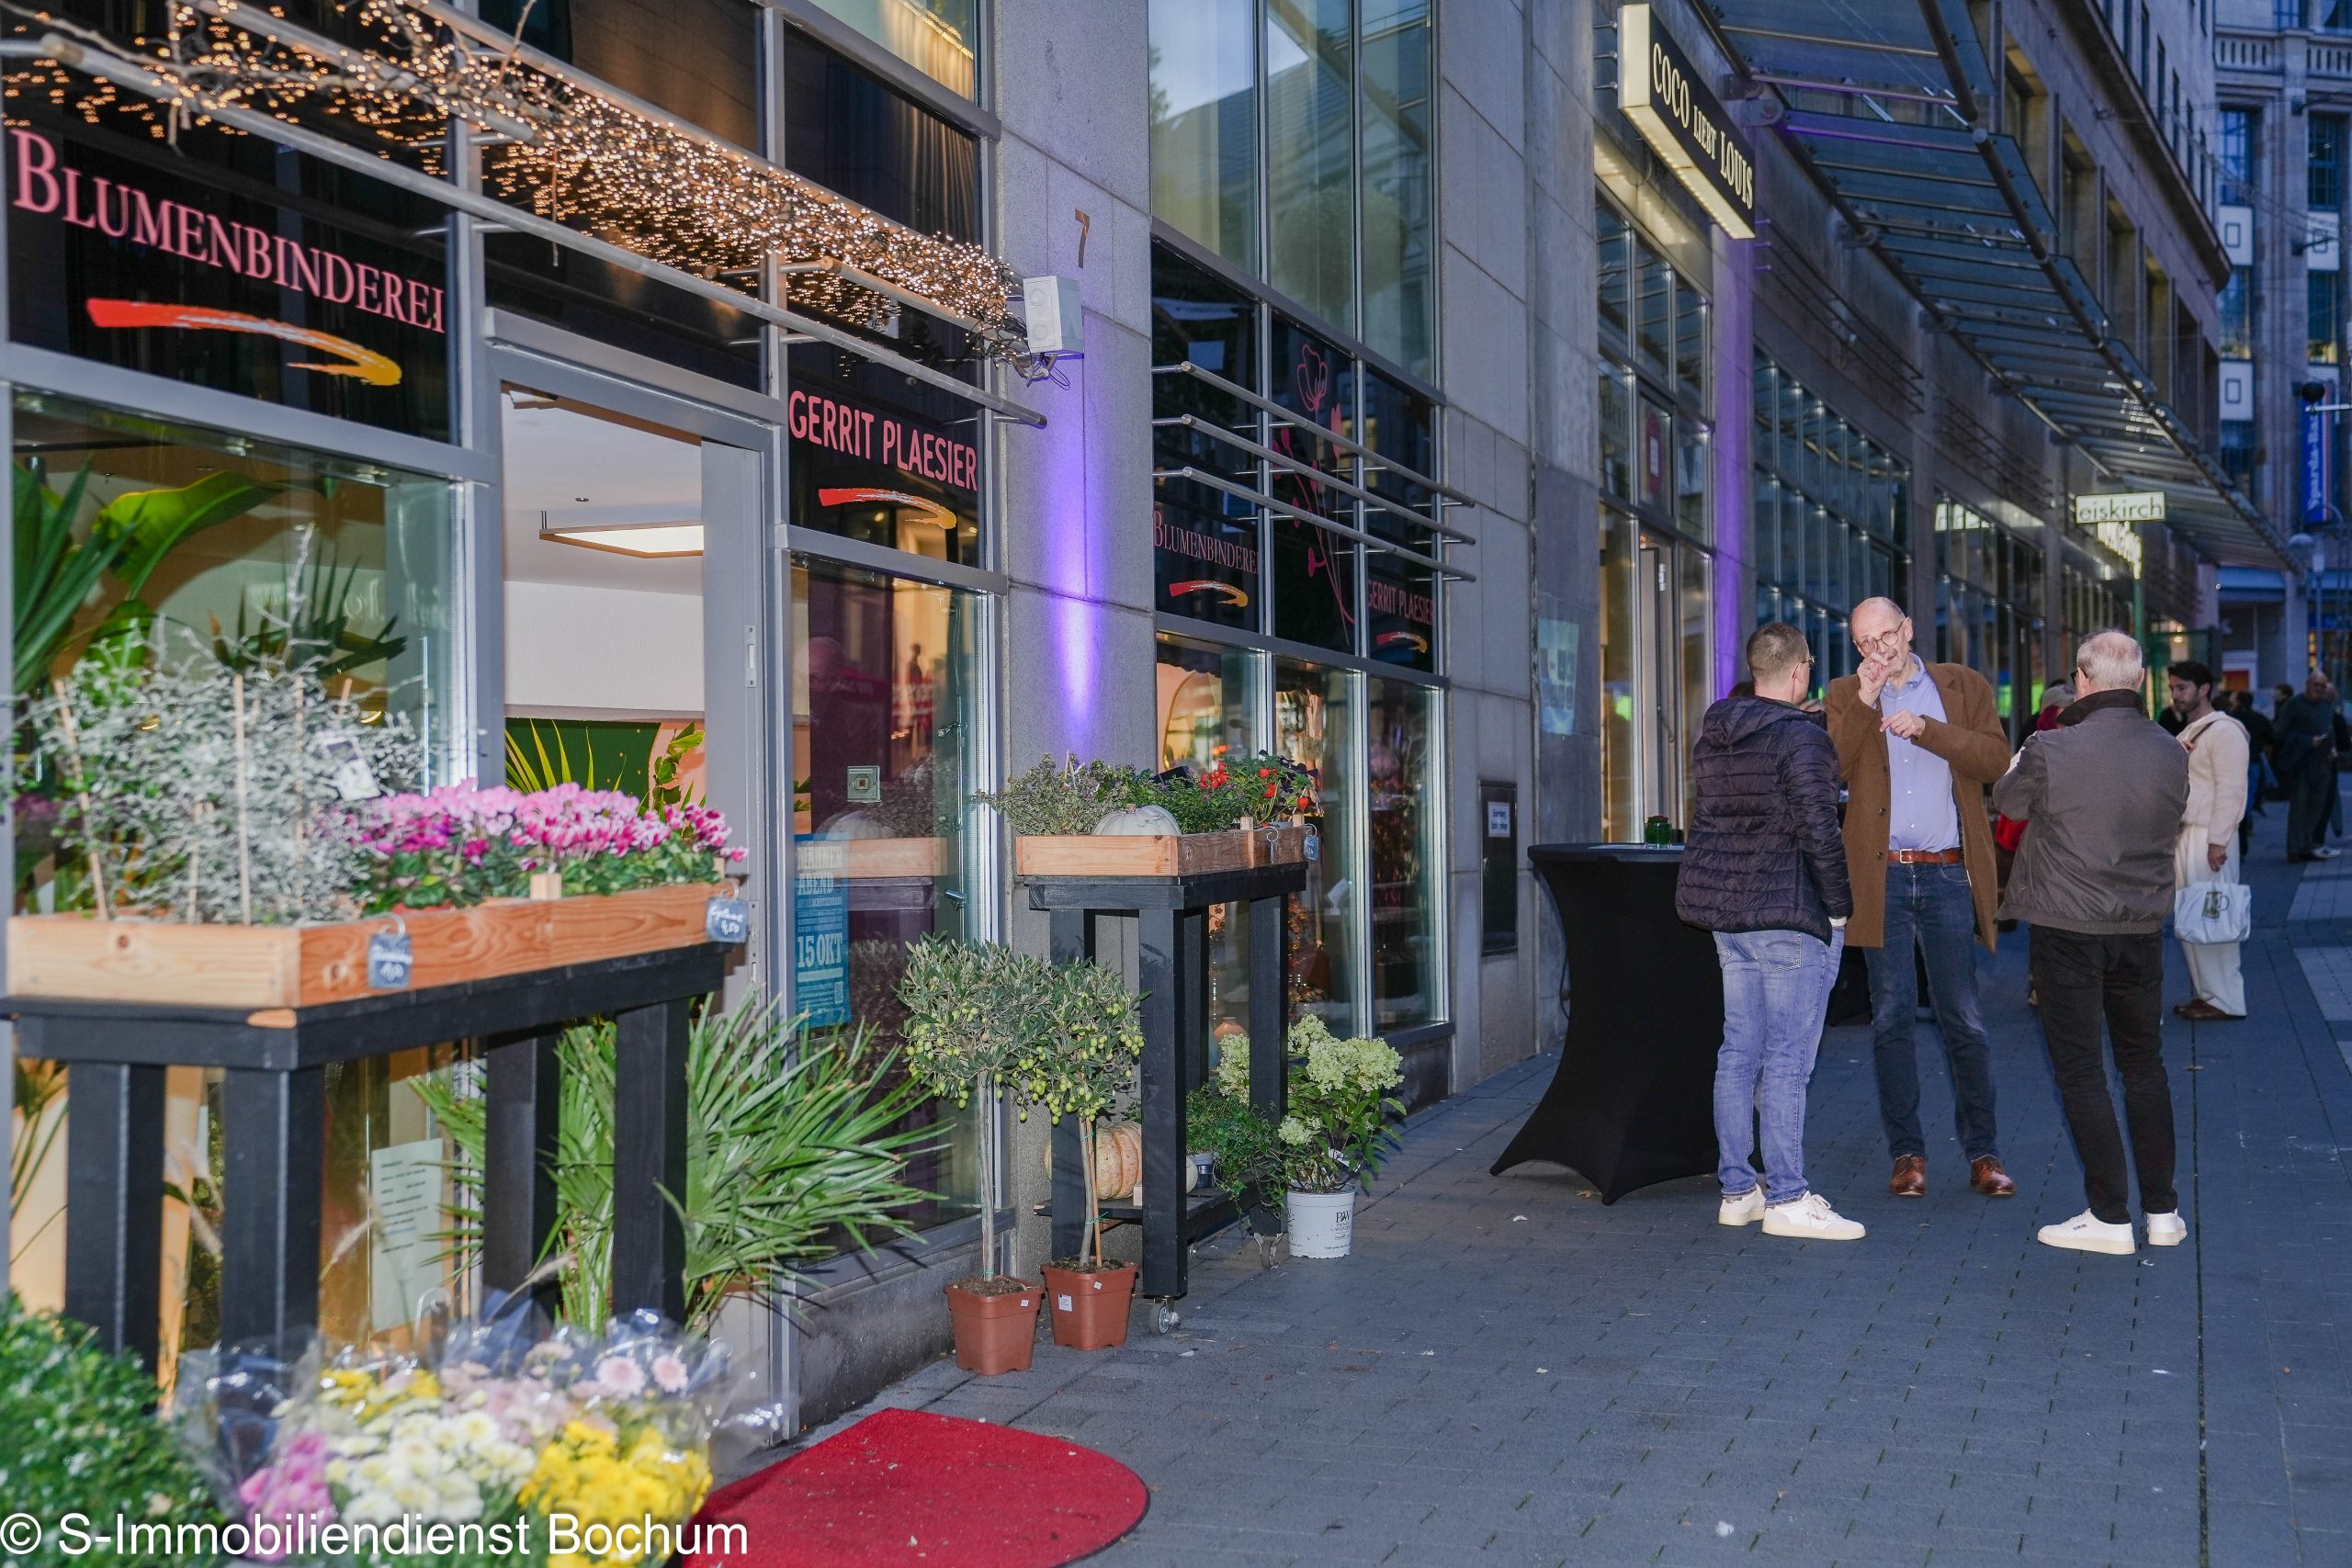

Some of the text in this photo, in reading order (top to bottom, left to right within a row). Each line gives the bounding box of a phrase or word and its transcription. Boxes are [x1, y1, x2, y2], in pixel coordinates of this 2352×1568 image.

[1653, 42, 1753, 209] COCO LIEBT LOUIS
[9, 128, 446, 333] BLUMENBINDEREI
[1073, 208, 1091, 269] 7
[788, 390, 978, 491] GERRIT PLAESIER
[2078, 497, 2164, 522] eiskirch
[1366, 579, 1396, 615] GERRIT
[797, 932, 843, 968] 15 OKT
